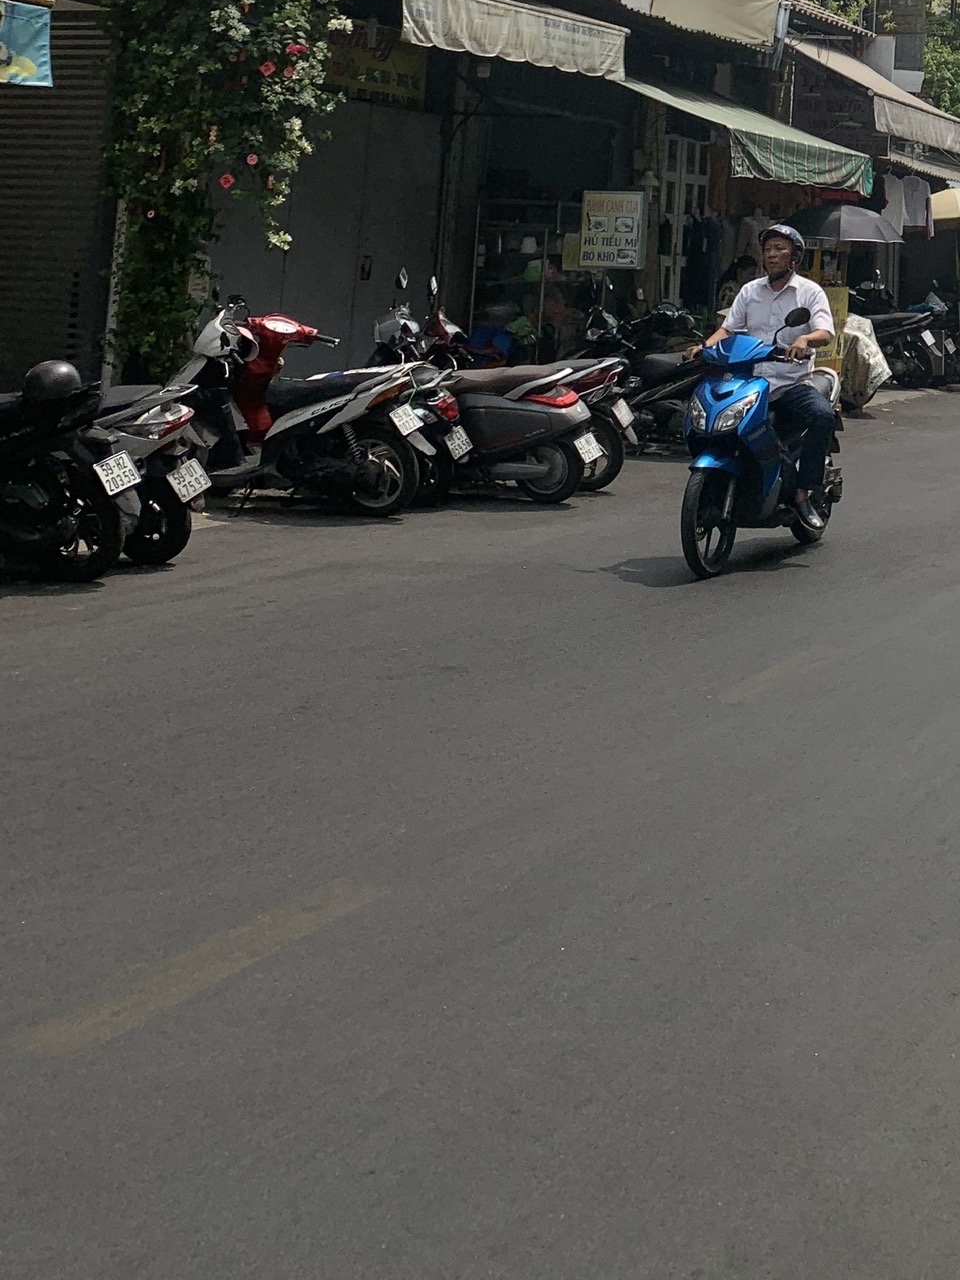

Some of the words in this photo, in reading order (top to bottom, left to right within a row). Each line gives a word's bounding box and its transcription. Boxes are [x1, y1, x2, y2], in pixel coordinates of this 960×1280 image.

[101, 456, 128, 478] 59-H2
[173, 464, 198, 486] 59-U1
[105, 468, 138, 493] 203.59
